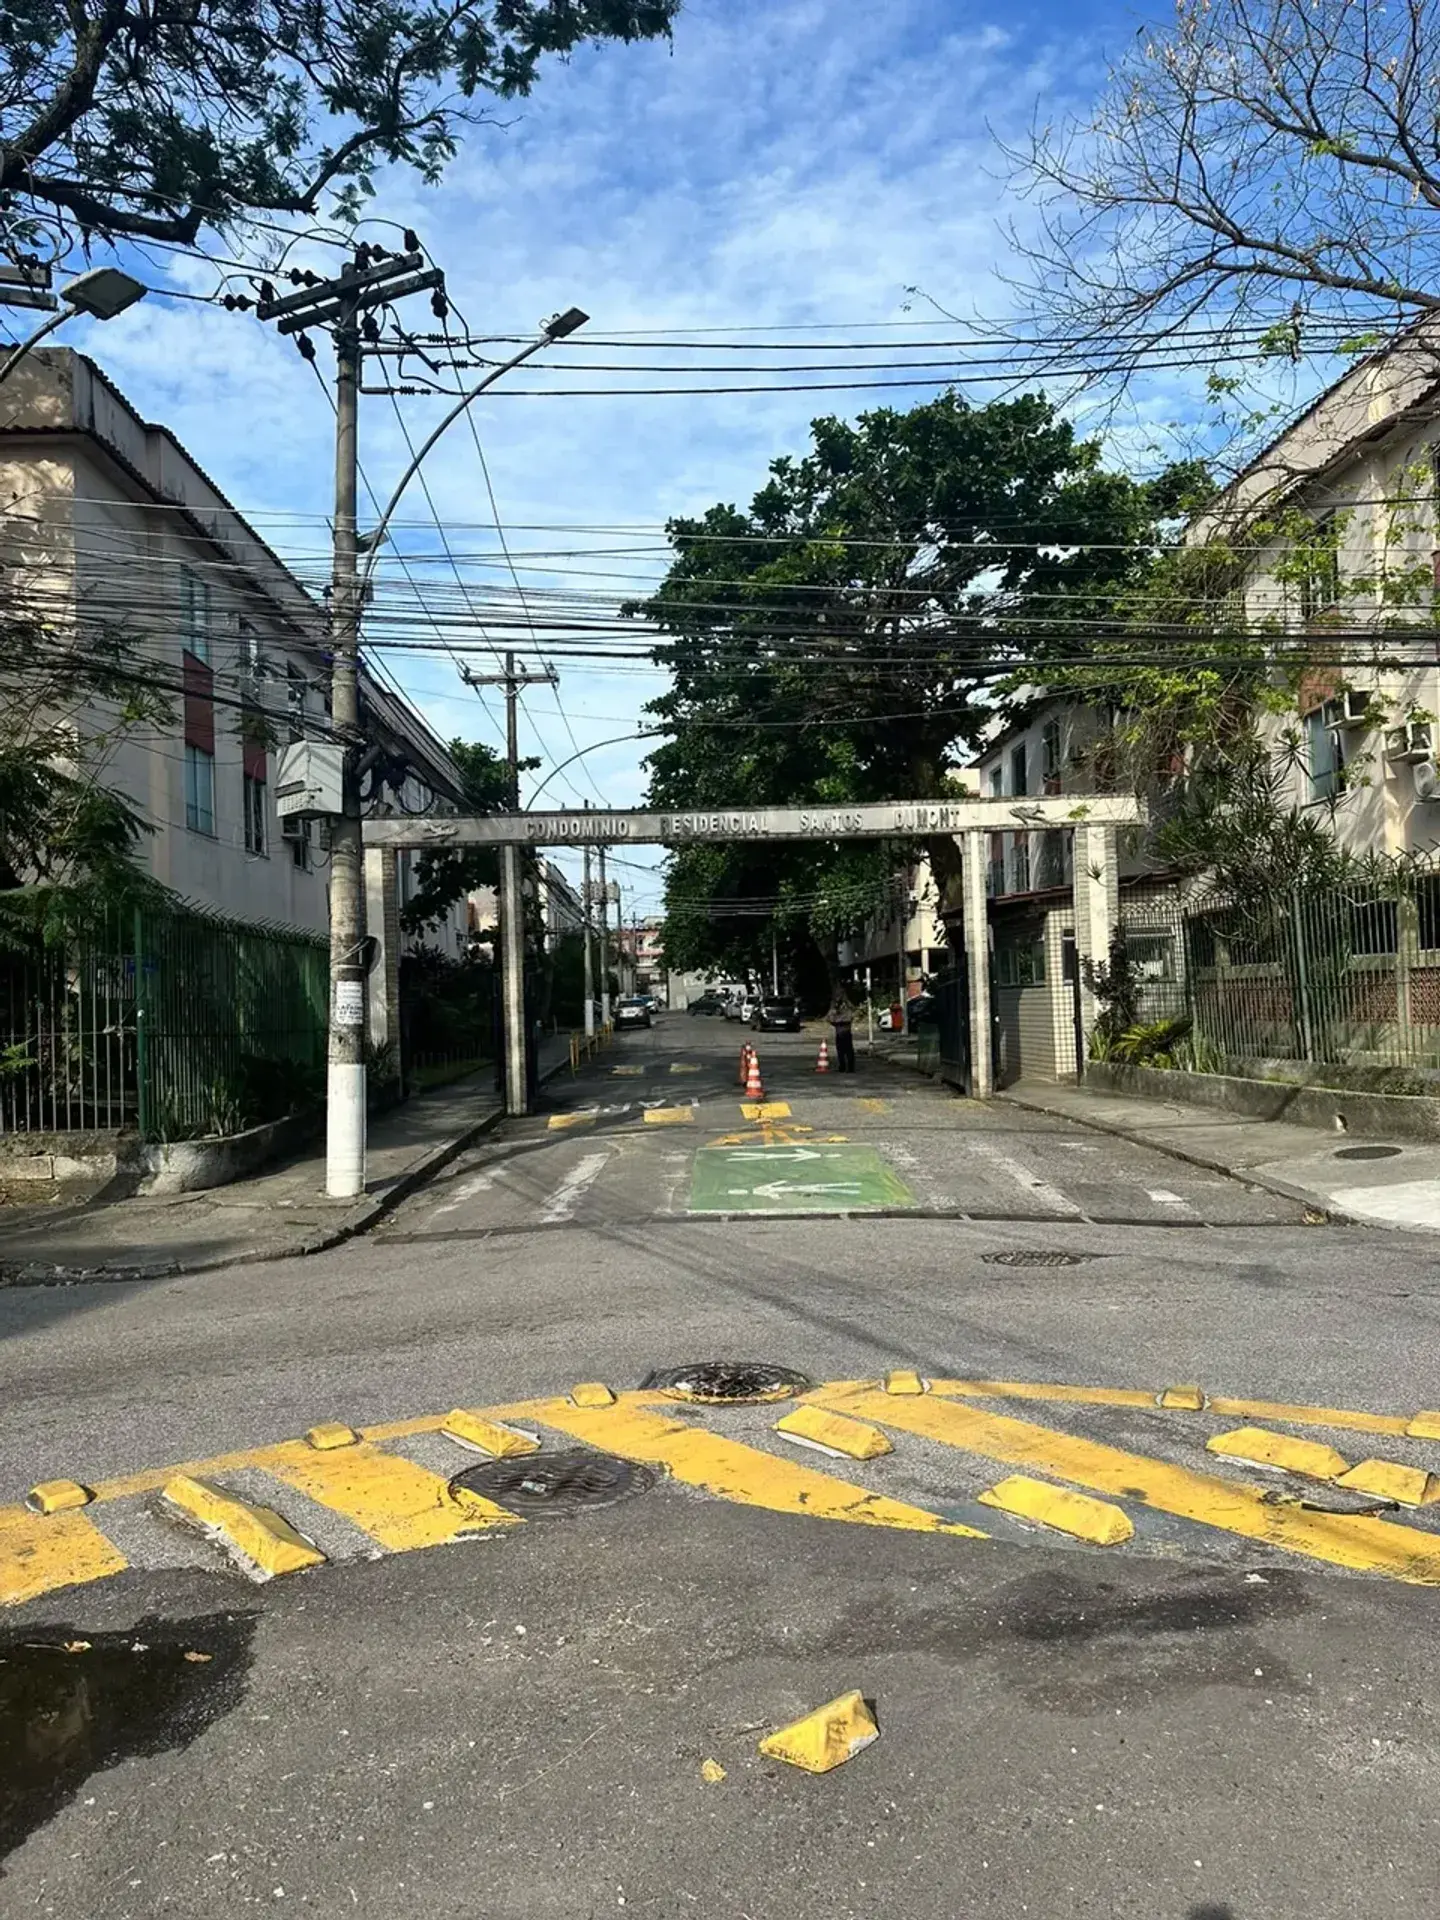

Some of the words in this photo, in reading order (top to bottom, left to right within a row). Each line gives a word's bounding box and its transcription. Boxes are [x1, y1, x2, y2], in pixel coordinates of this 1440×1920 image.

[660, 813, 769, 836] RESIDENCIAL
[800, 811, 864, 832] SANTOS
[894, 807, 960, 829] DUMONT
